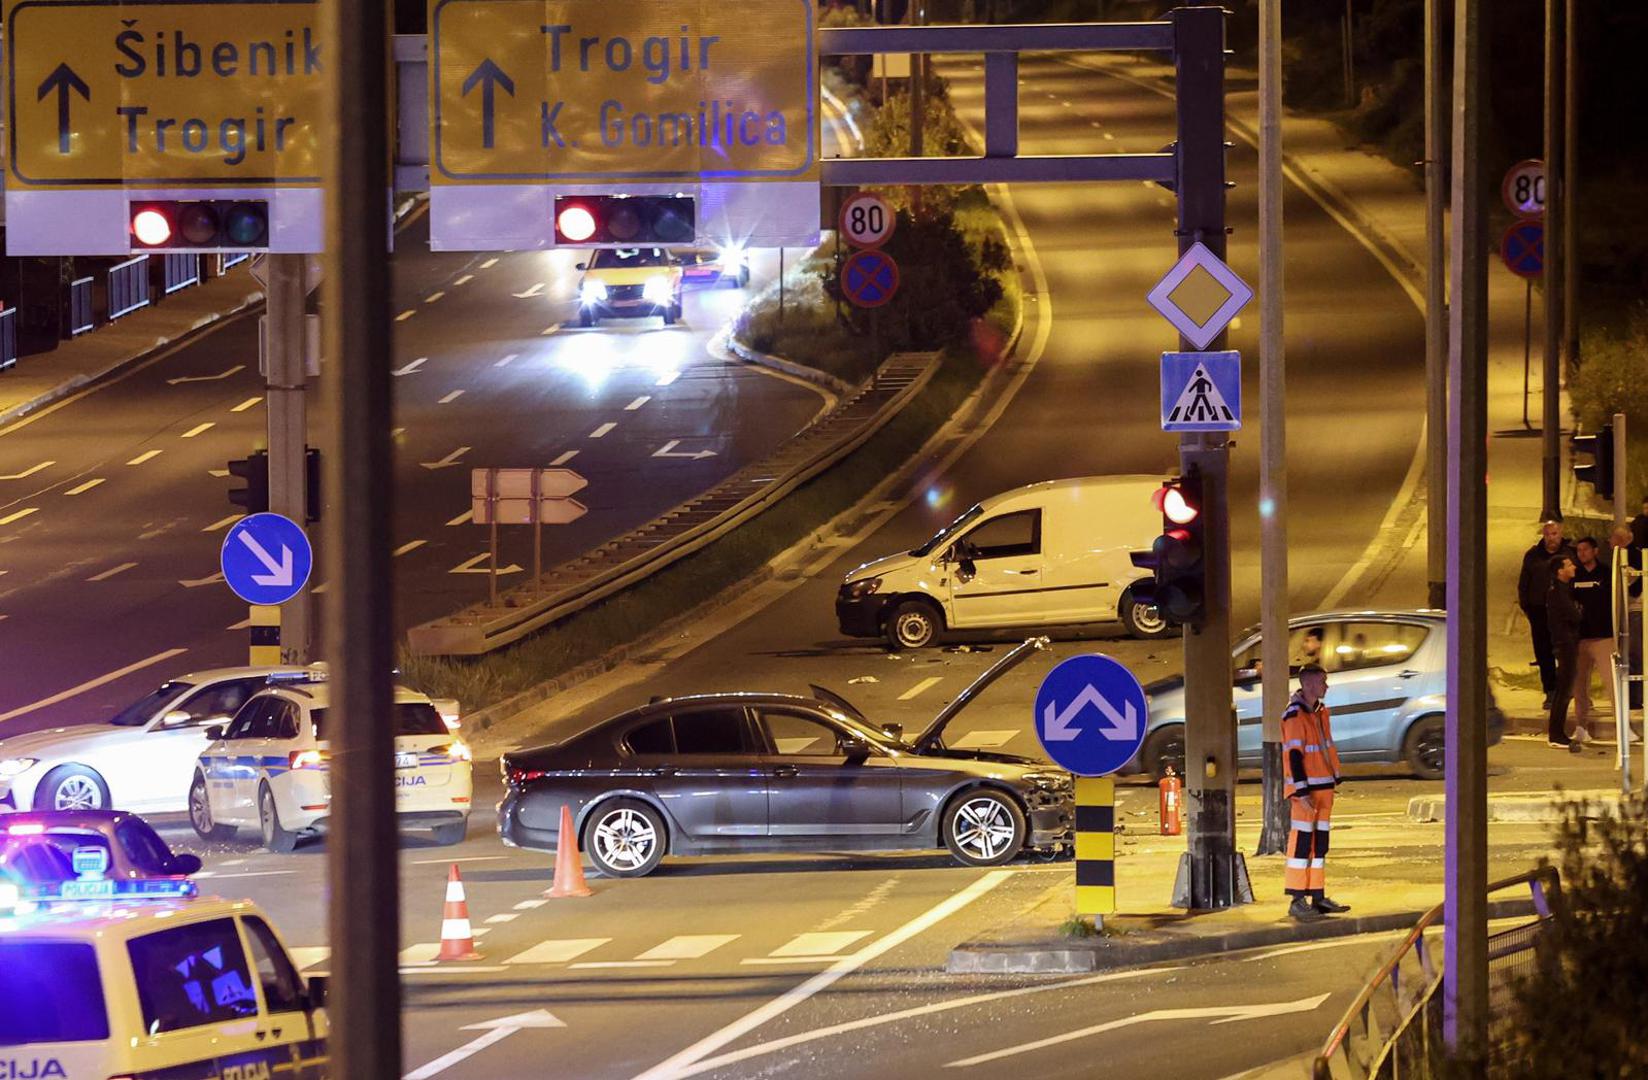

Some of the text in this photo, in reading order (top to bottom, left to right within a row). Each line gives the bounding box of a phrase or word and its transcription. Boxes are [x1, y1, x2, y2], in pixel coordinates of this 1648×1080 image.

[115, 19, 324, 77] Šibenik
[540, 25, 720, 84] Trogir
[116, 106, 295, 165] Trogir
[541, 99, 787, 148] K. Gomilica
[1515, 175, 1545, 204] 80
[851, 205, 884, 235] 80
